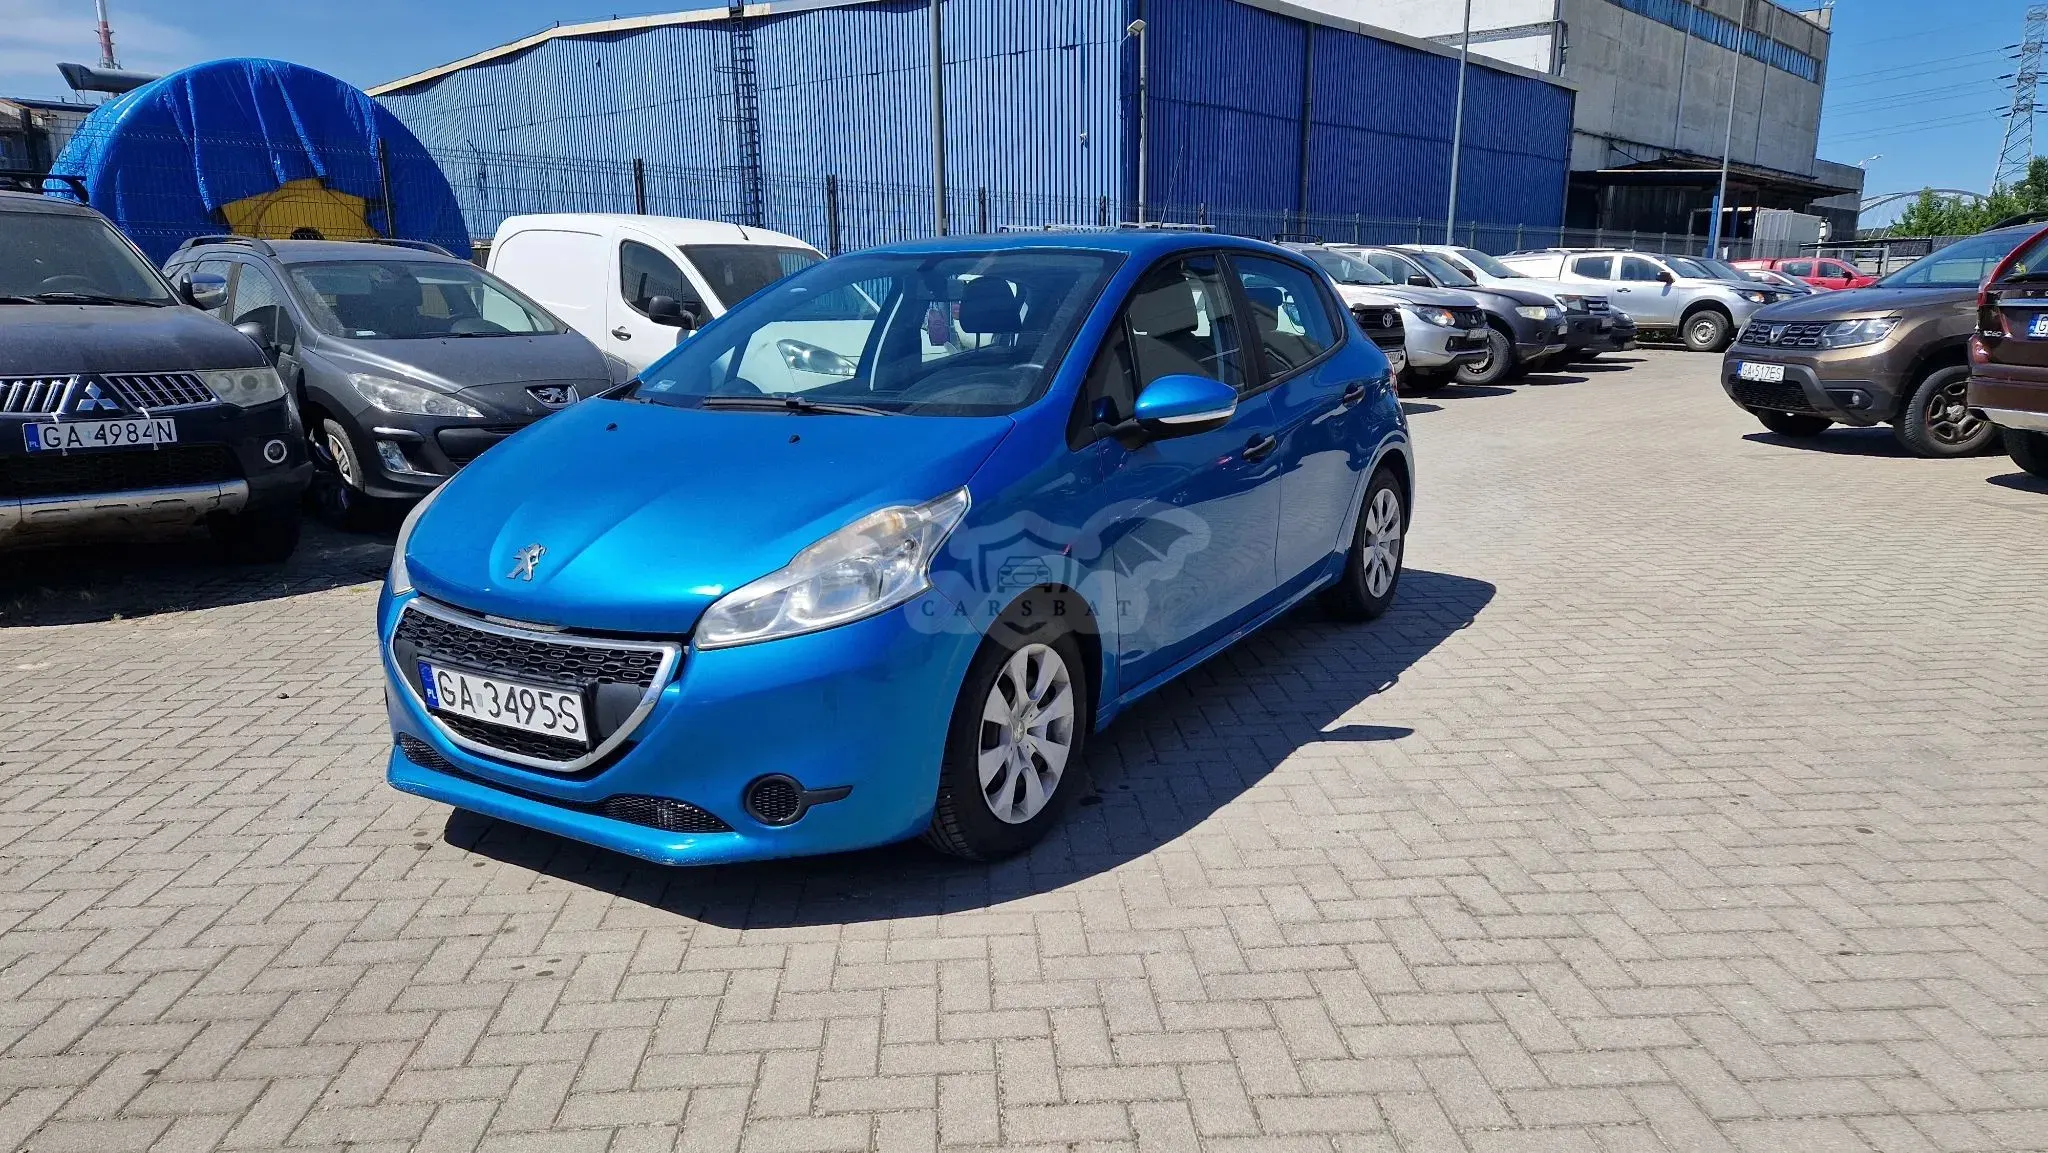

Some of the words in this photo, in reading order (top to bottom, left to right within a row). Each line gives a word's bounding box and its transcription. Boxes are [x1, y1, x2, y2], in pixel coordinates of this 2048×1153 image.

[43, 425, 83, 448] GA
[94, 420, 173, 445] 4984N
[427, 687, 437, 700] PL
[437, 670, 476, 714] GA
[483, 681, 579, 734] 3495S
